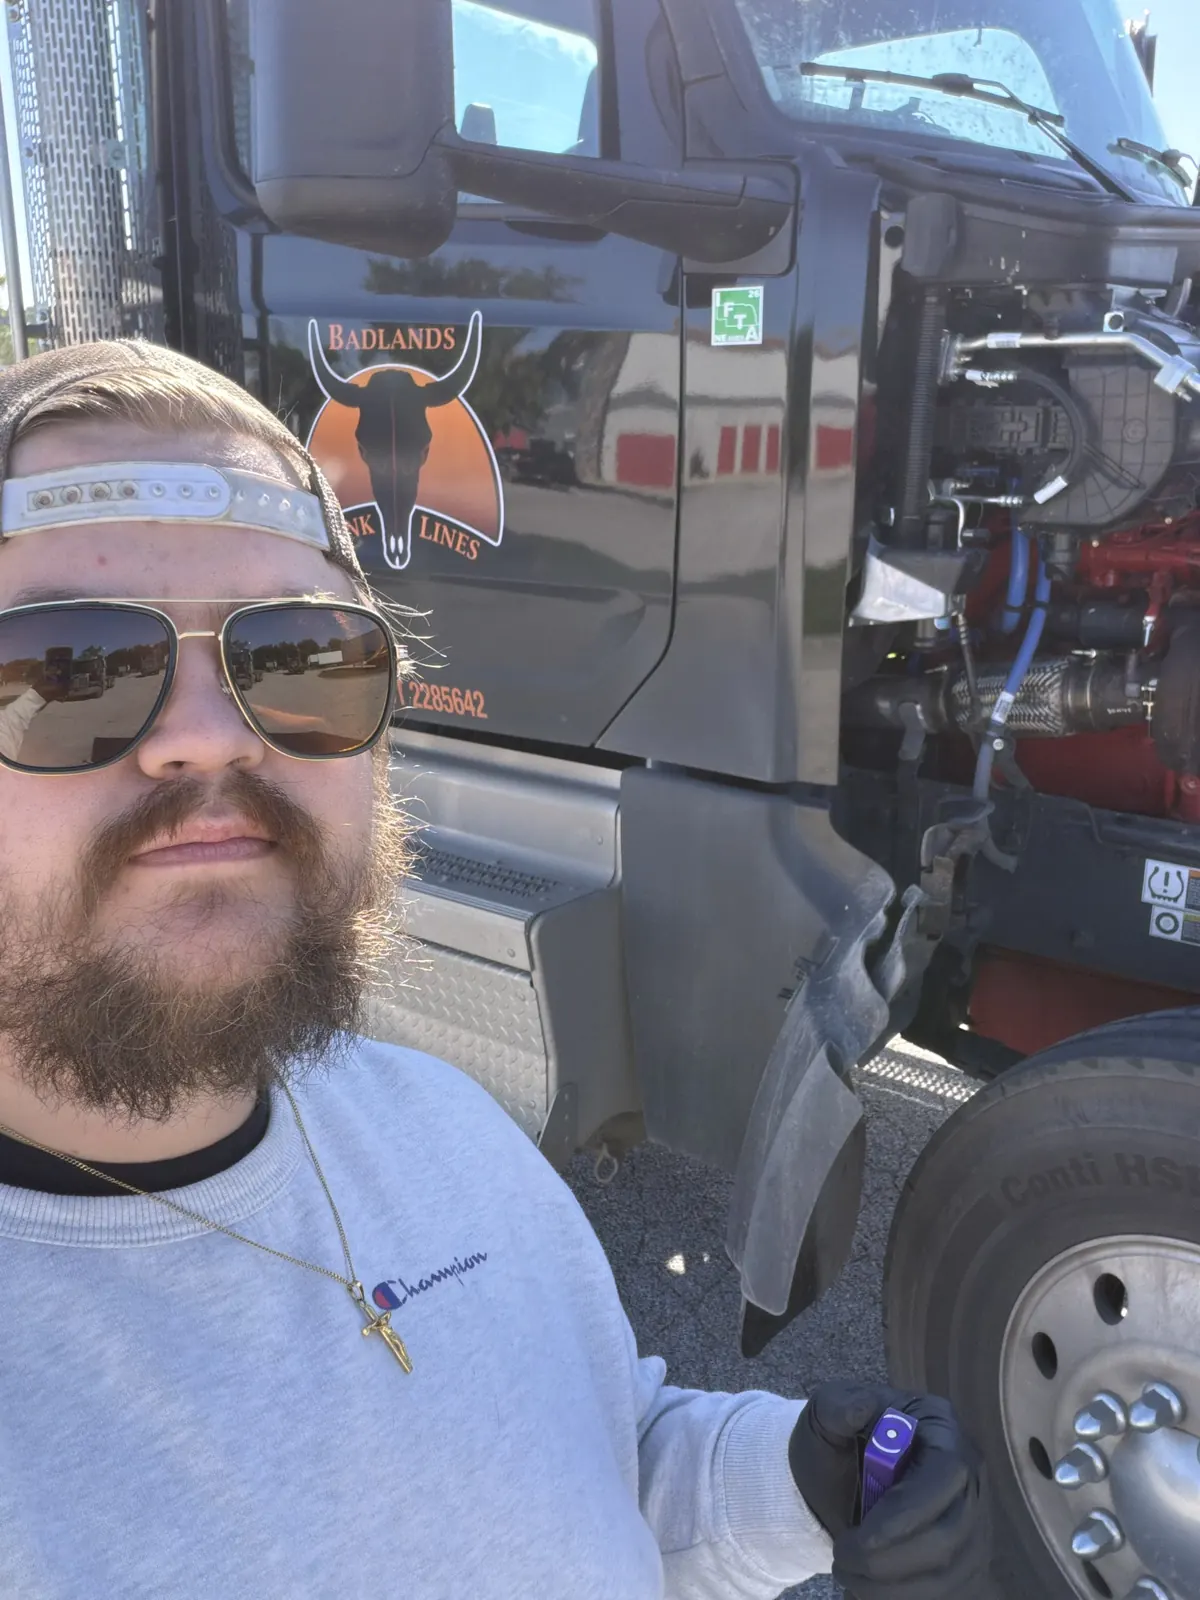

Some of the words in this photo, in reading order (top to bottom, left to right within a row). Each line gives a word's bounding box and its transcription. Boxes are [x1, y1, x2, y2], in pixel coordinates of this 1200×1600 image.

[419, 515, 481, 561] LINES
[408, 680, 488, 719] 2285642
[1000, 1152, 1104, 1208] Conti
[372, 1252, 488, 1311] Champion
